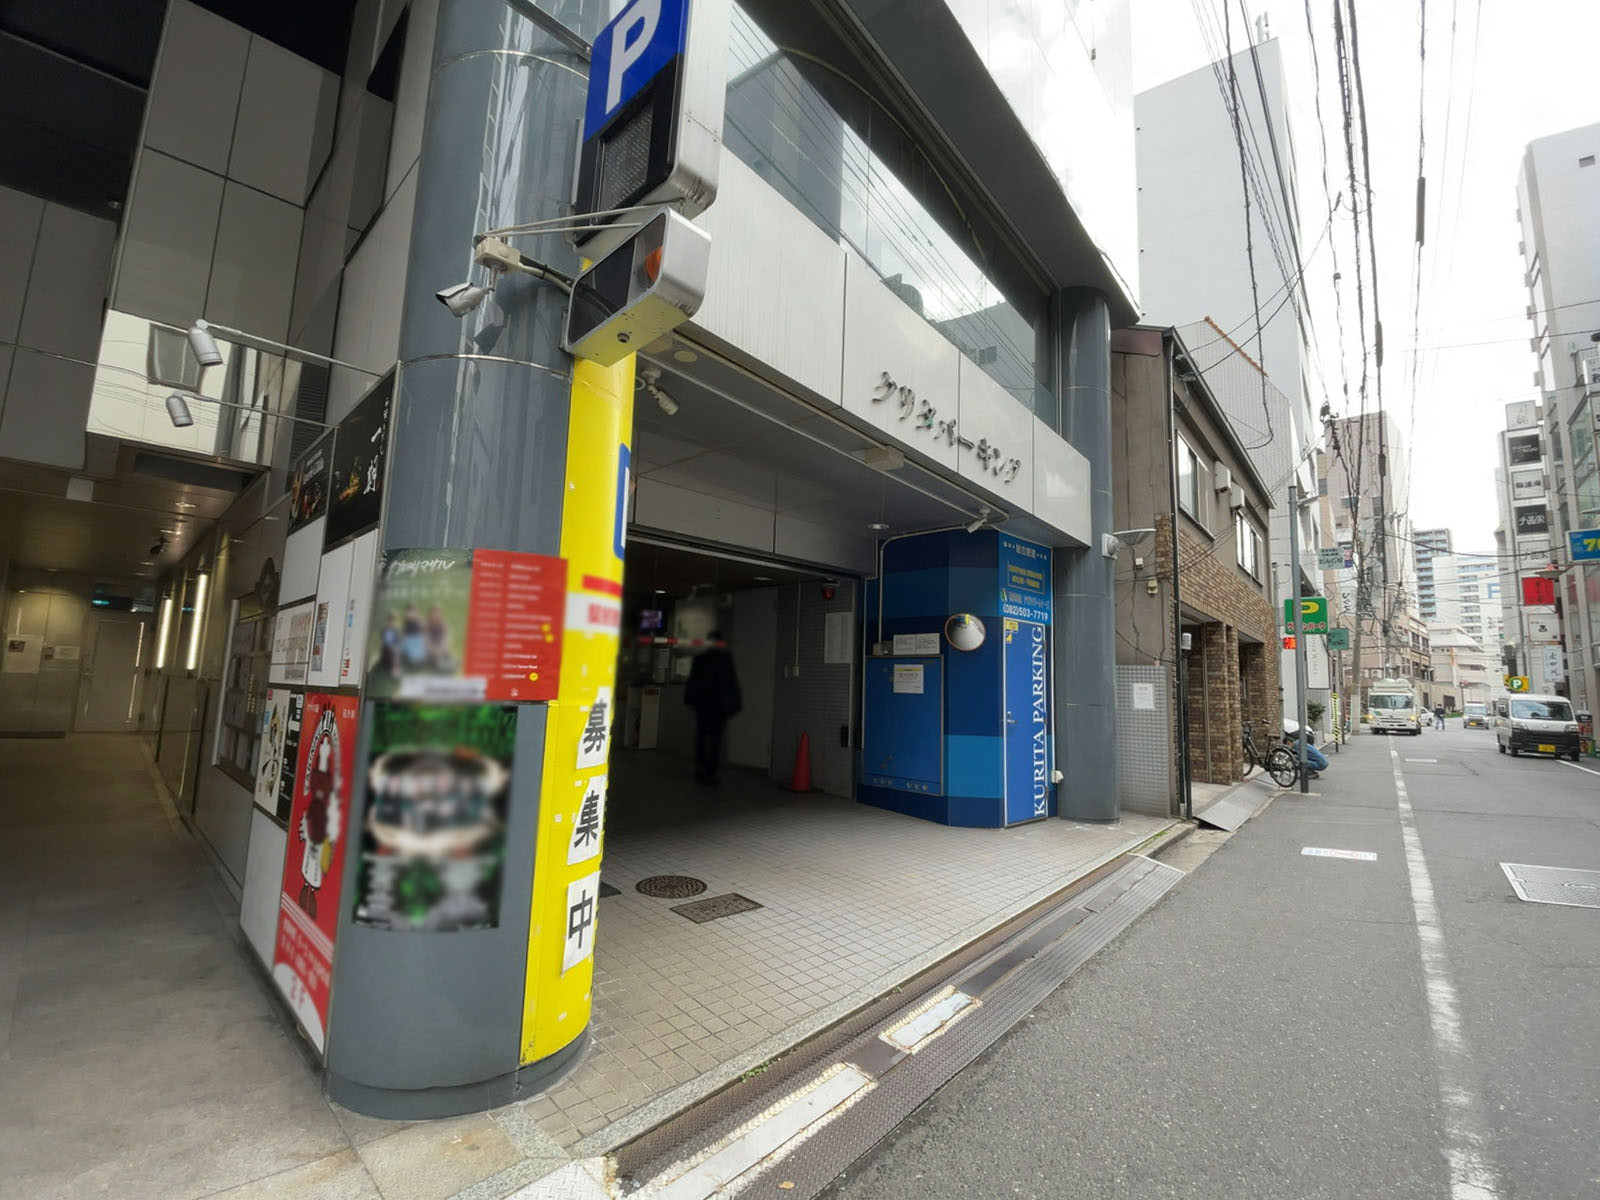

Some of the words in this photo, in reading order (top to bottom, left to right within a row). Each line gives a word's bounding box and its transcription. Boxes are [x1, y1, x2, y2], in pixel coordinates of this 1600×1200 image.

[606, 0, 662, 116] P
[871, 370, 1022, 484] クリタパーキング
[1287, 621, 1326, 632] グンパーク
[1032, 627, 1046, 723] PARKING
[1513, 678, 1522, 688] P
[1033, 729, 1046, 816] KURITA
[568, 698, 607, 949] 募集中
